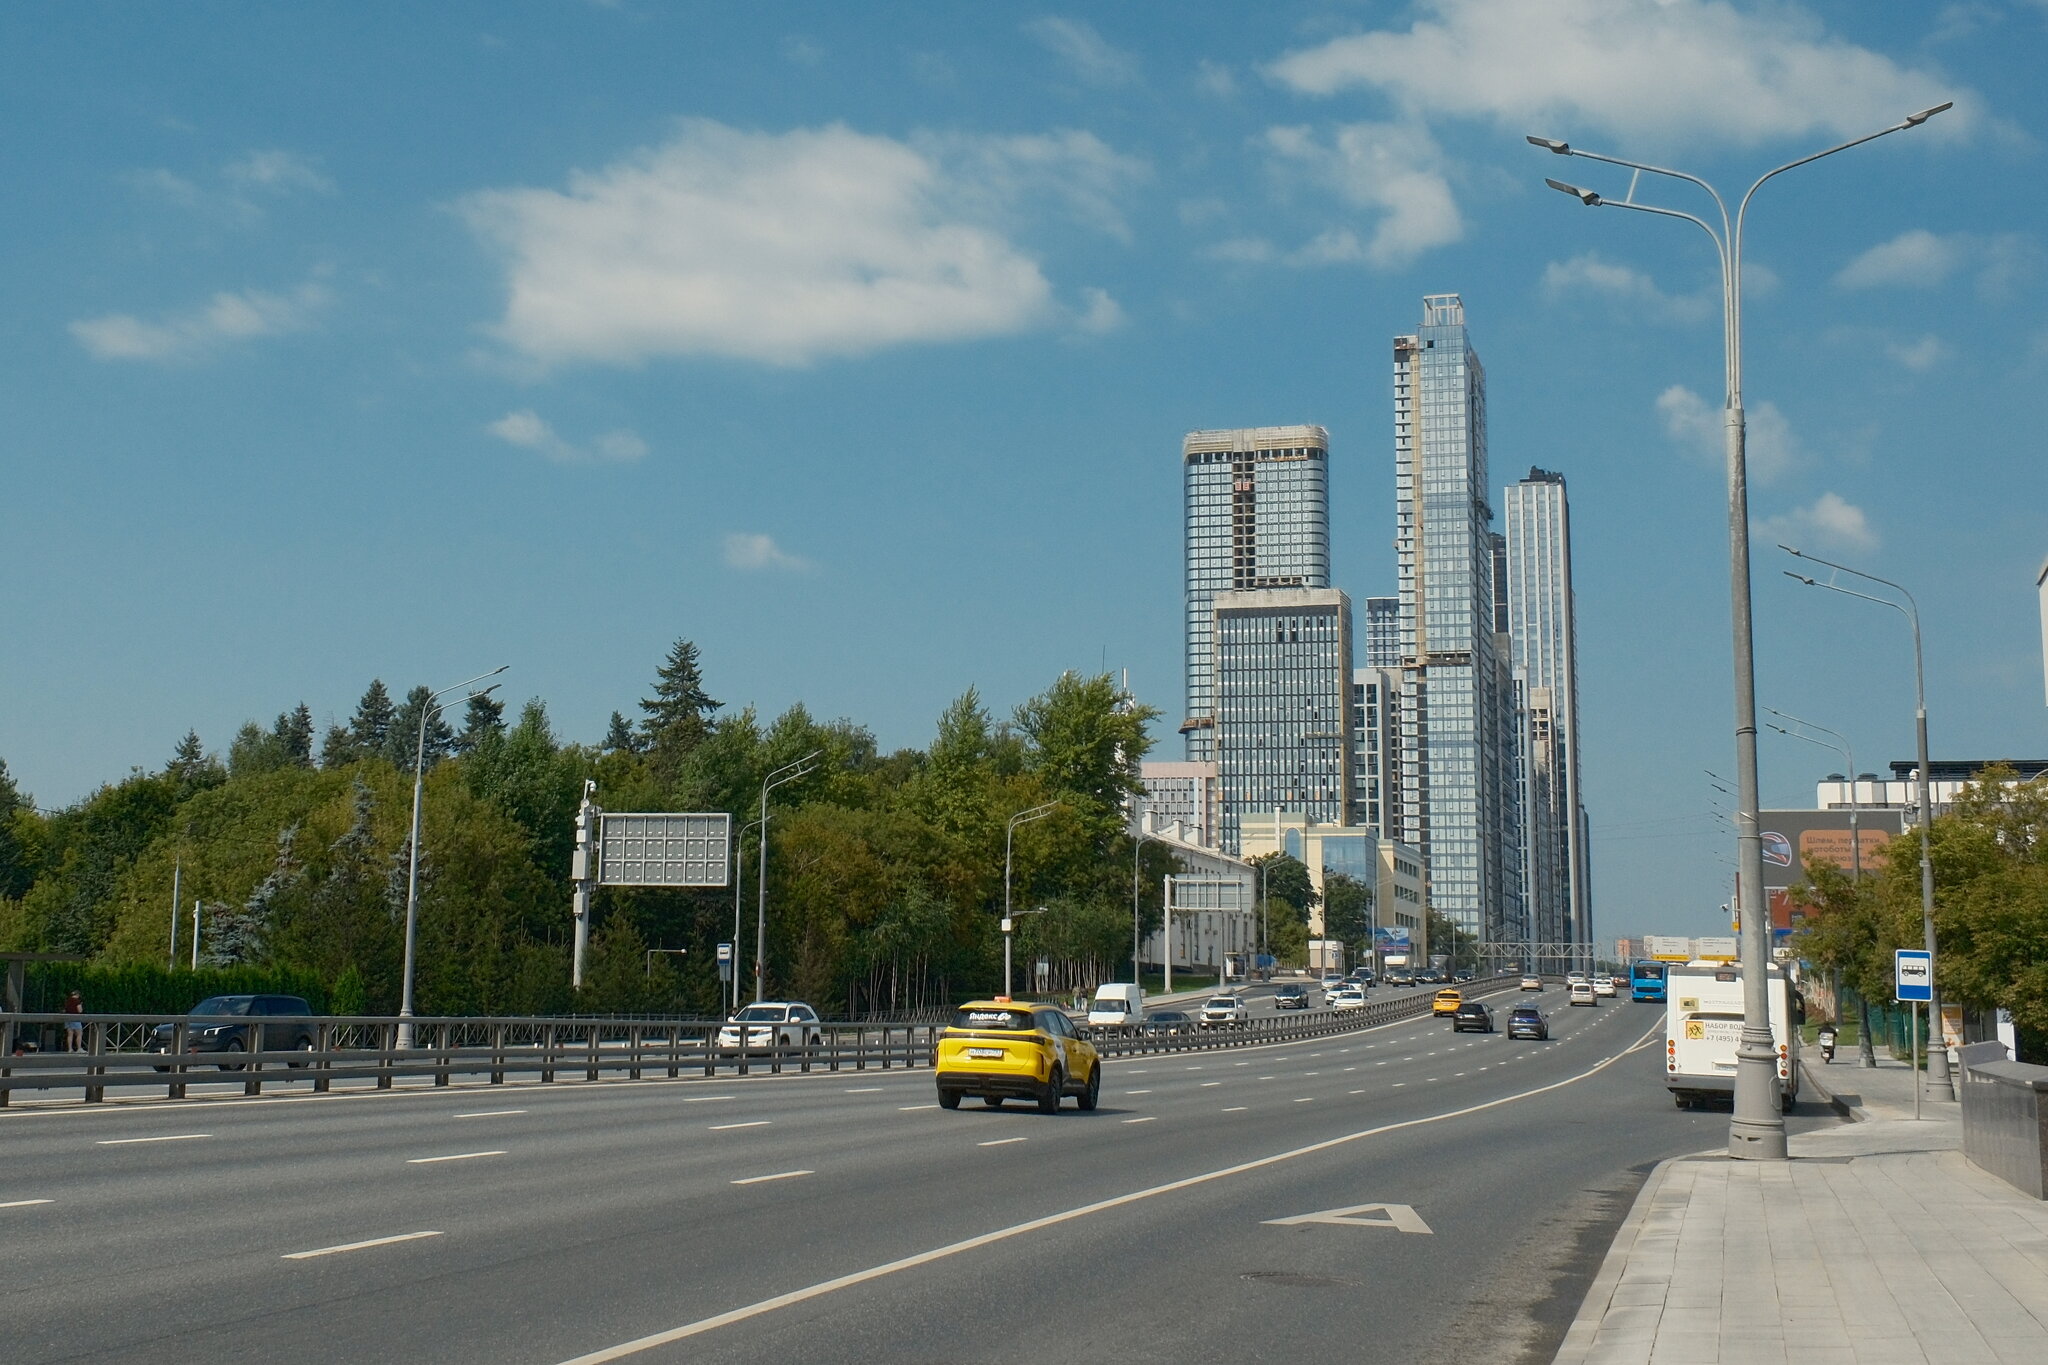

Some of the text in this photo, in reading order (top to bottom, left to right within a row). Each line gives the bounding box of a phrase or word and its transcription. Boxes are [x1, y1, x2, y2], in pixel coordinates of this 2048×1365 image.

[1807, 836, 1835, 844] Шлем,
[969, 1012, 998, 1020] Яндекс
[1729, 1023, 1744, 1031] ВОД
[1716, 1035, 1734, 1043] (495)
